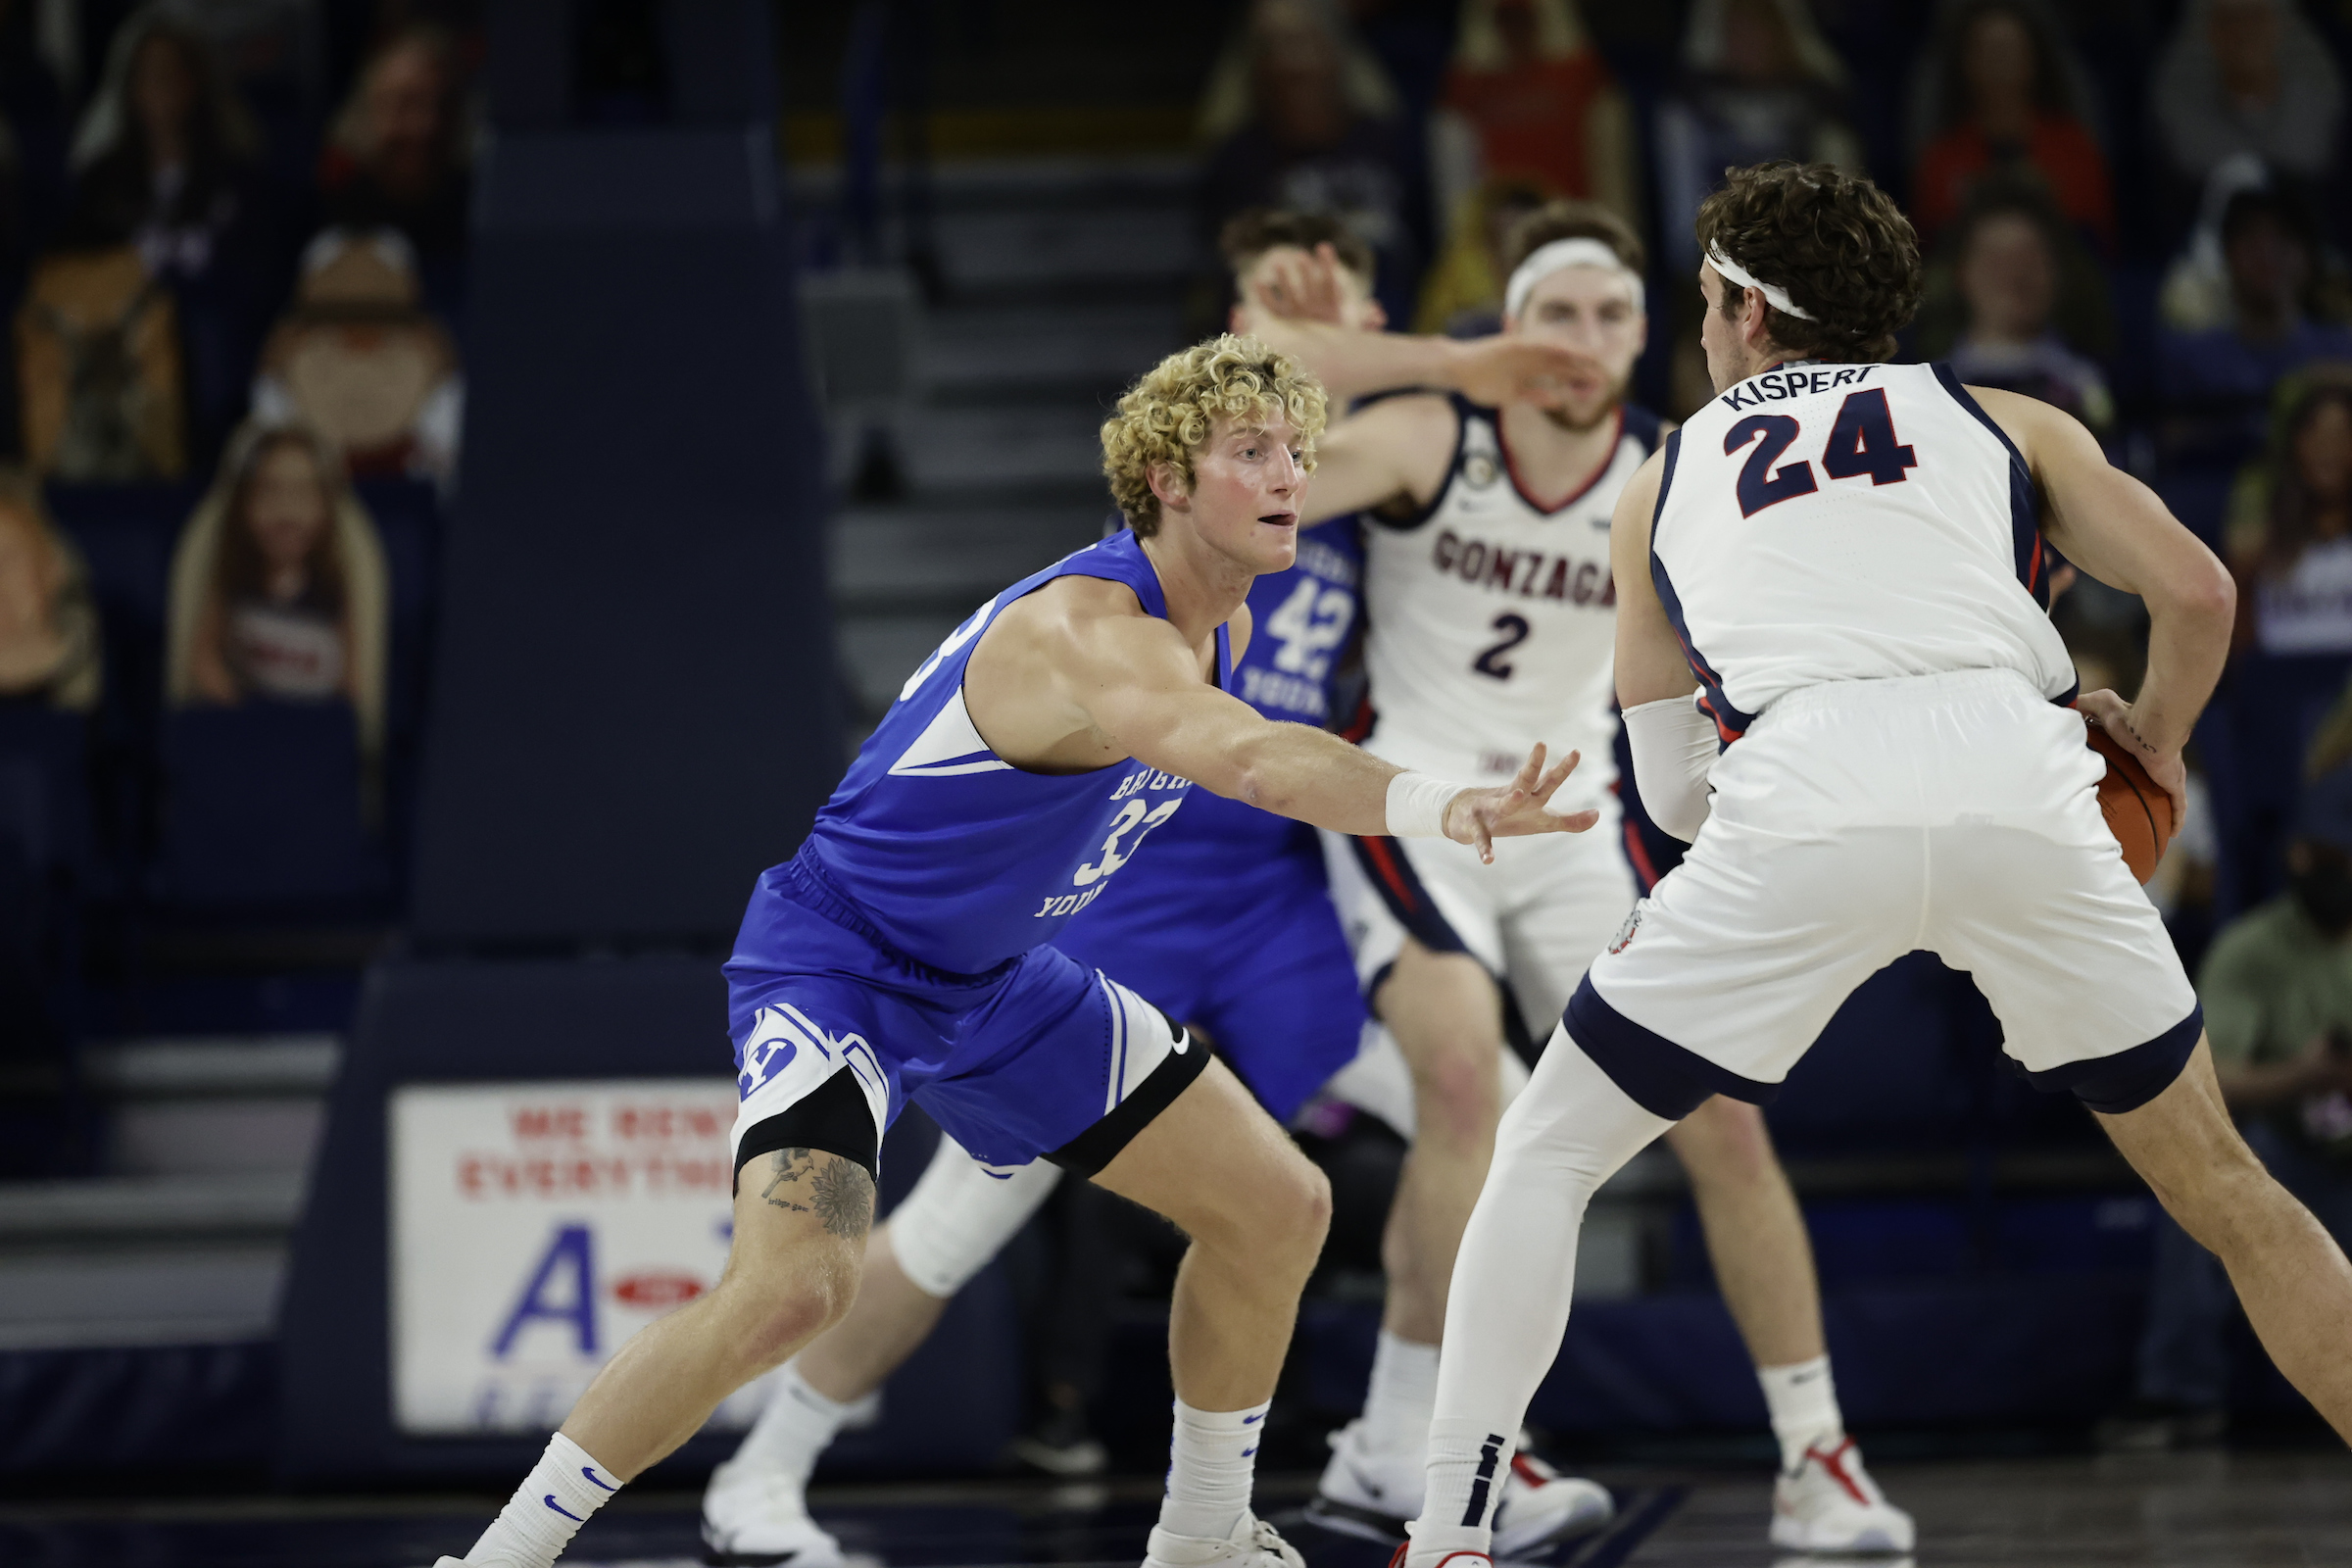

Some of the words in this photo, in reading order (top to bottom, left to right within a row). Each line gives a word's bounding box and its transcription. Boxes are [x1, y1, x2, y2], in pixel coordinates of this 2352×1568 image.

[1721, 365, 1880, 412] KISPERT
[1724, 387, 1918, 519] 24
[1266, 576, 1354, 681] 42
[1473, 613, 1529, 678] 2
[615, 1105, 738, 1142] REN
[488, 1222, 600, 1358] A
